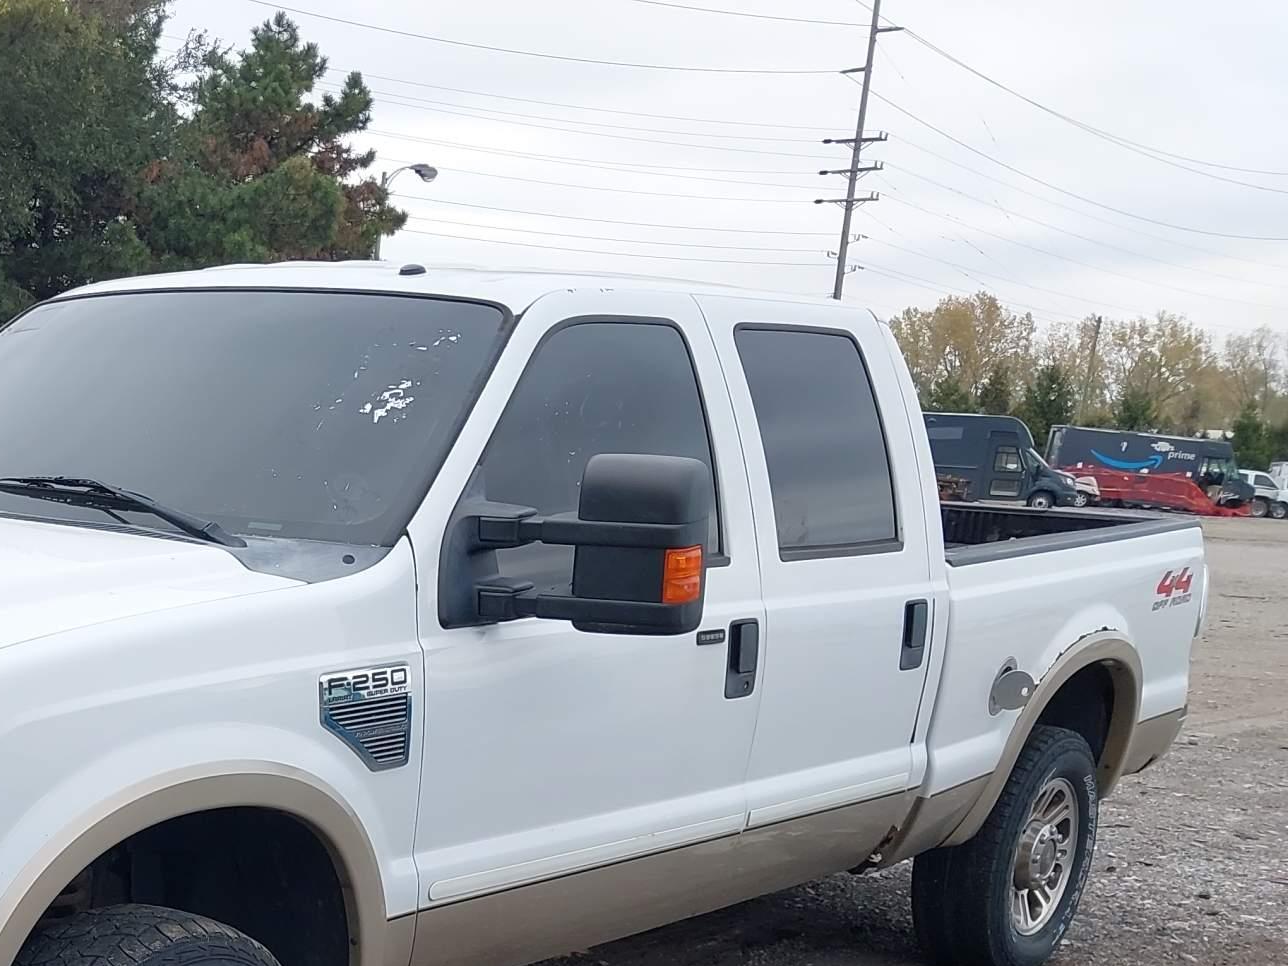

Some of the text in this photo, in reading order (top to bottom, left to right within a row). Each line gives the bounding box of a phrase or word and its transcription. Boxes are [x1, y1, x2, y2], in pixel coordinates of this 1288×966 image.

[1168, 450, 1196, 460] prime
[366, 685, 407, 697] SUPER DUTY
